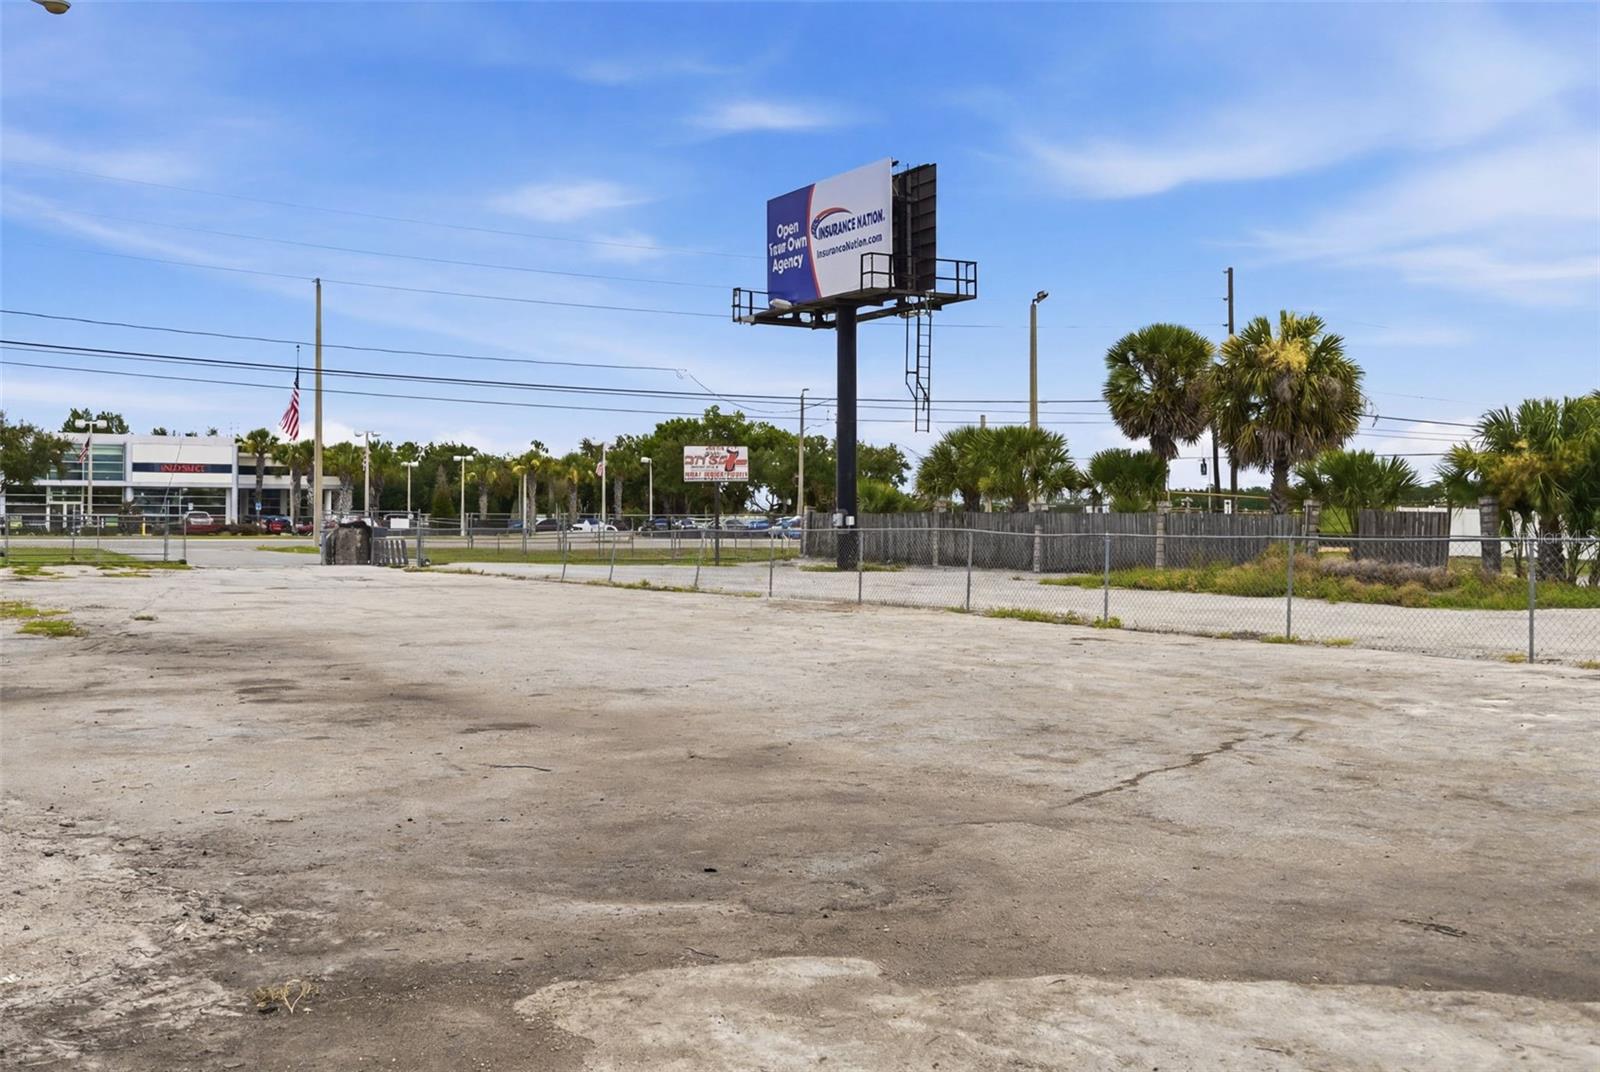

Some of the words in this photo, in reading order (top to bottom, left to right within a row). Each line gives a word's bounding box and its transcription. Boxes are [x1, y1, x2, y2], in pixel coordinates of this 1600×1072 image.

[777, 222, 799, 239] Open
[819, 217, 855, 240] INSURANCE
[788, 236, 807, 251] Own
[772, 254, 803, 274] Agency
